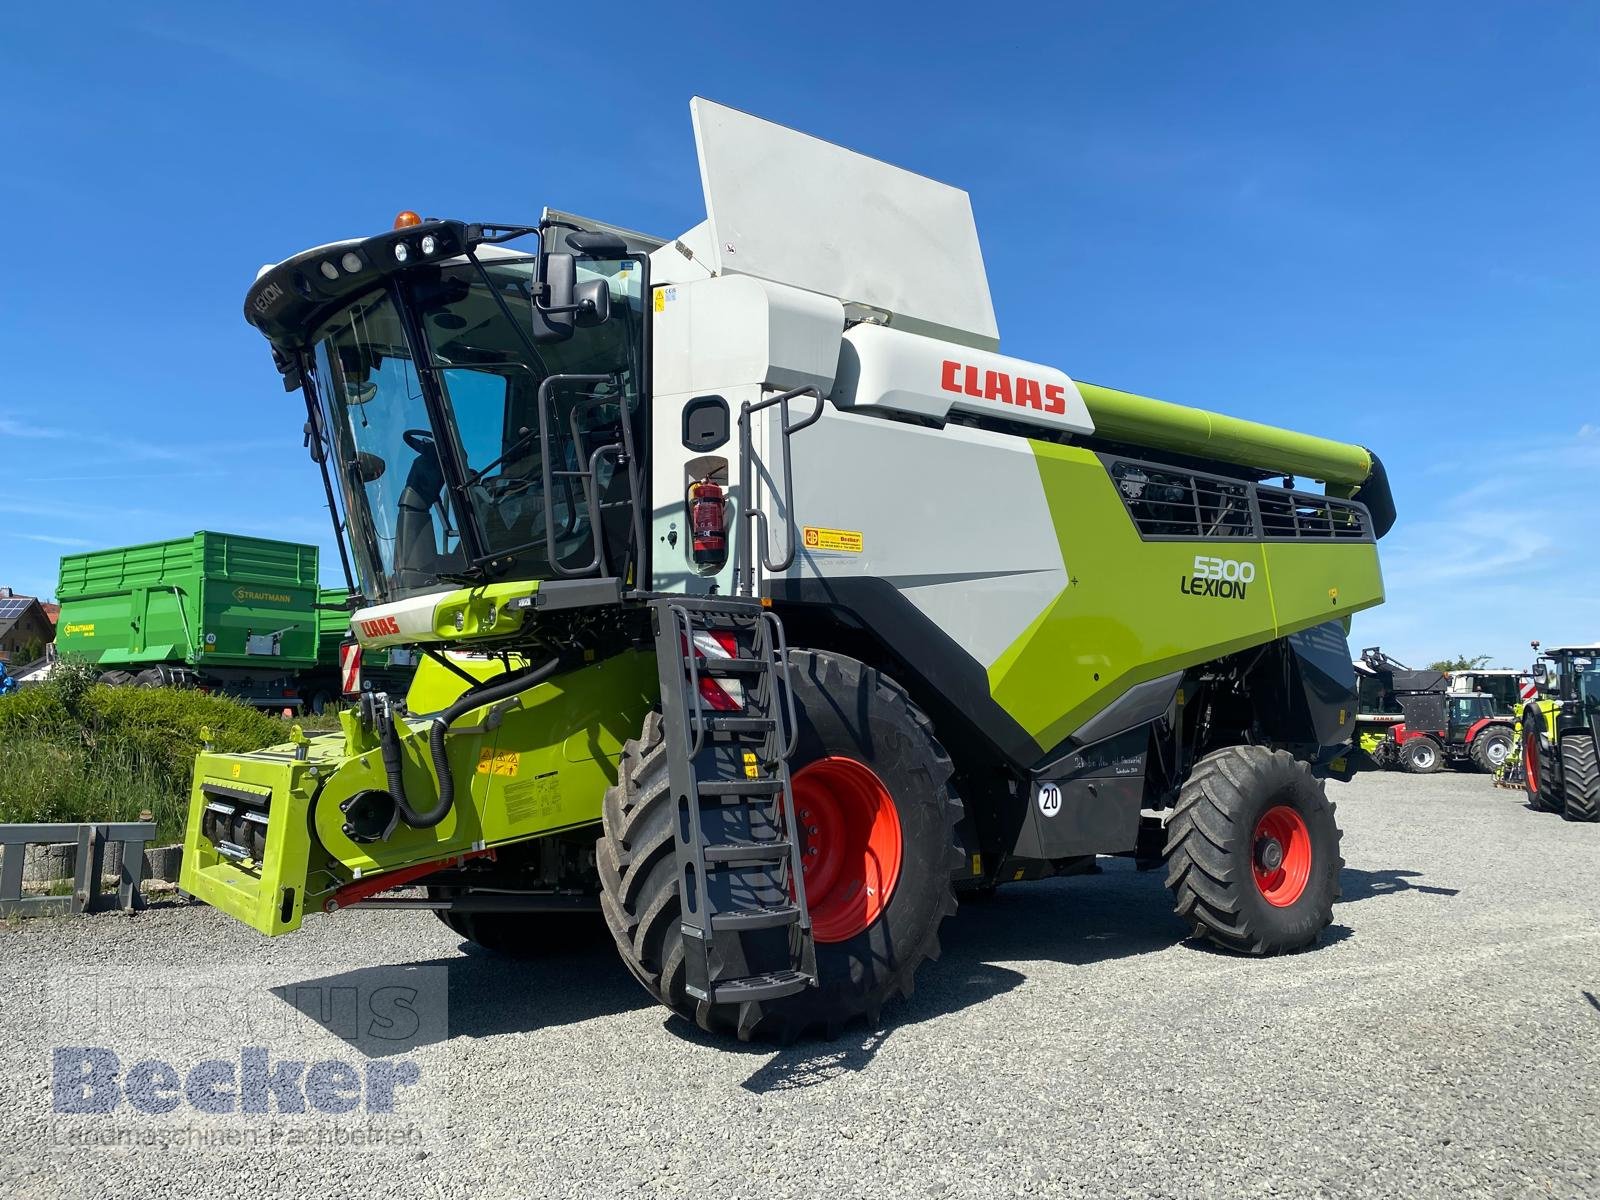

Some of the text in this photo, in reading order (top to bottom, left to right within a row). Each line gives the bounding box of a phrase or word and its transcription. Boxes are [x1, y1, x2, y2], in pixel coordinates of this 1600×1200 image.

[941, 360, 1066, 415] CLAAS
[1193, 555, 1255, 583] 5300
[1181, 575, 1247, 600] LEXION
[1043, 788, 1058, 809] 20
